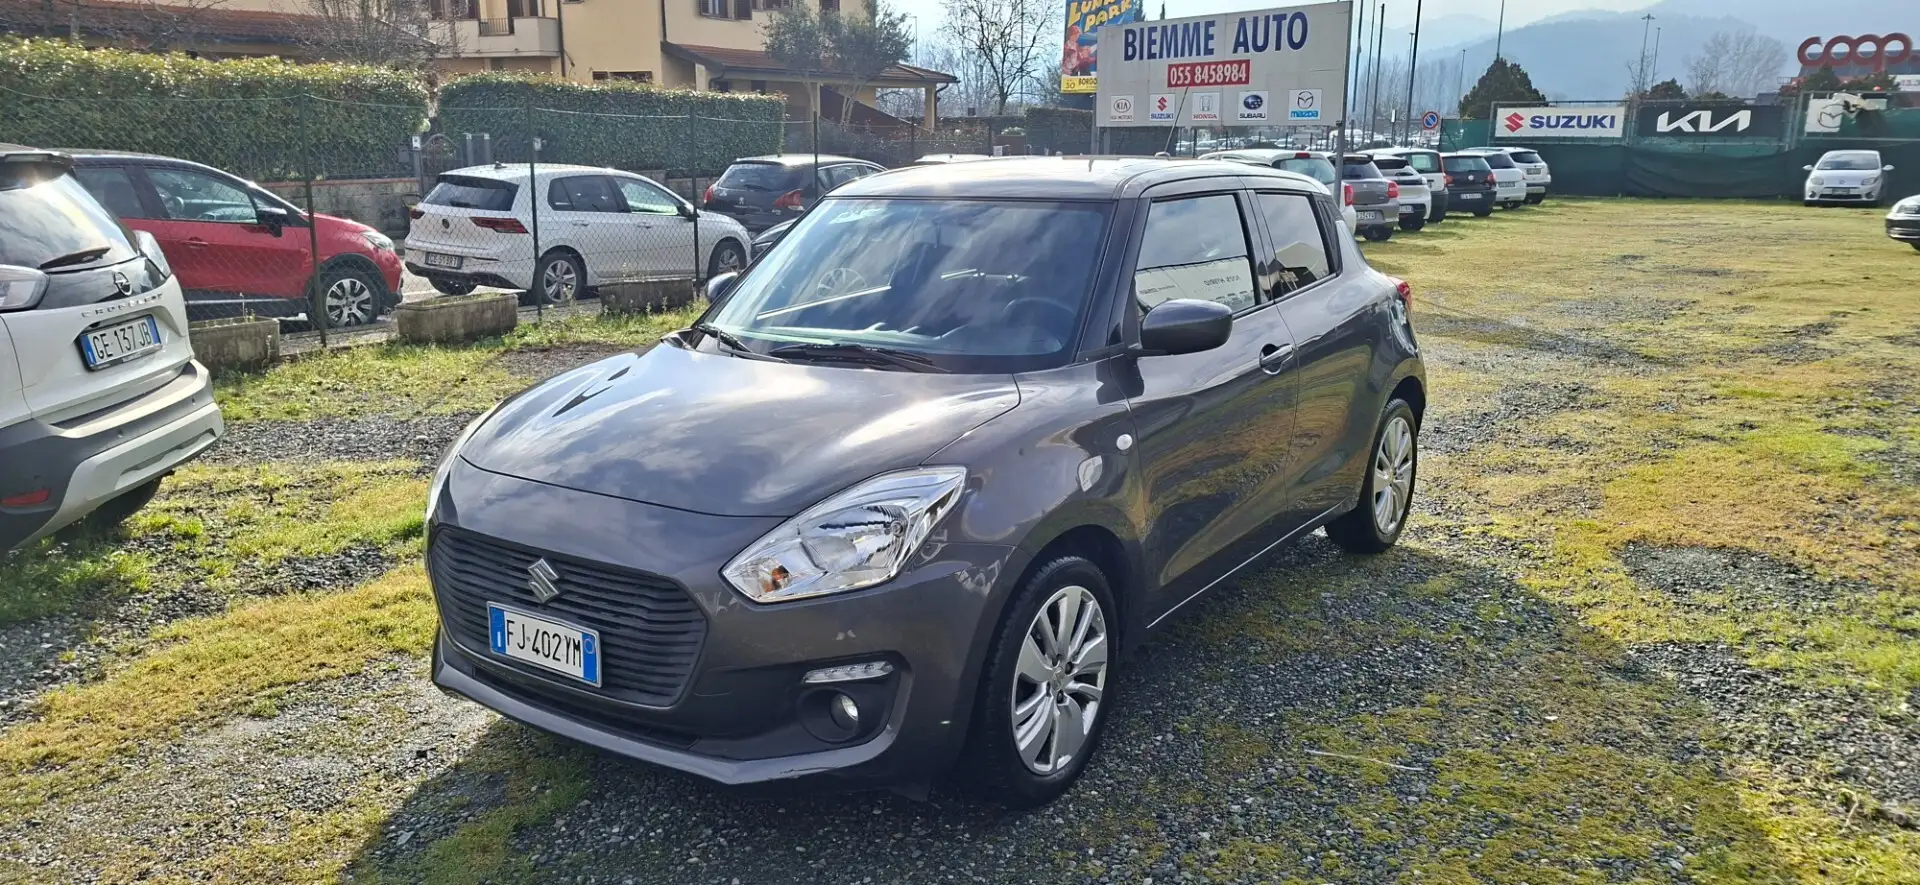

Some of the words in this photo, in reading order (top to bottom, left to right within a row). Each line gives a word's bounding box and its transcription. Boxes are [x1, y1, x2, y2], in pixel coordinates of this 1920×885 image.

[1123, 20, 1216, 61] BIEMME
[1232, 11, 1308, 54] AUTO
[1797, 33, 1912, 73] coop
[1170, 66, 1191, 85] 055
[1194, 63, 1246, 83] 8458984
[1529, 114, 1616, 129] SUZUKI
